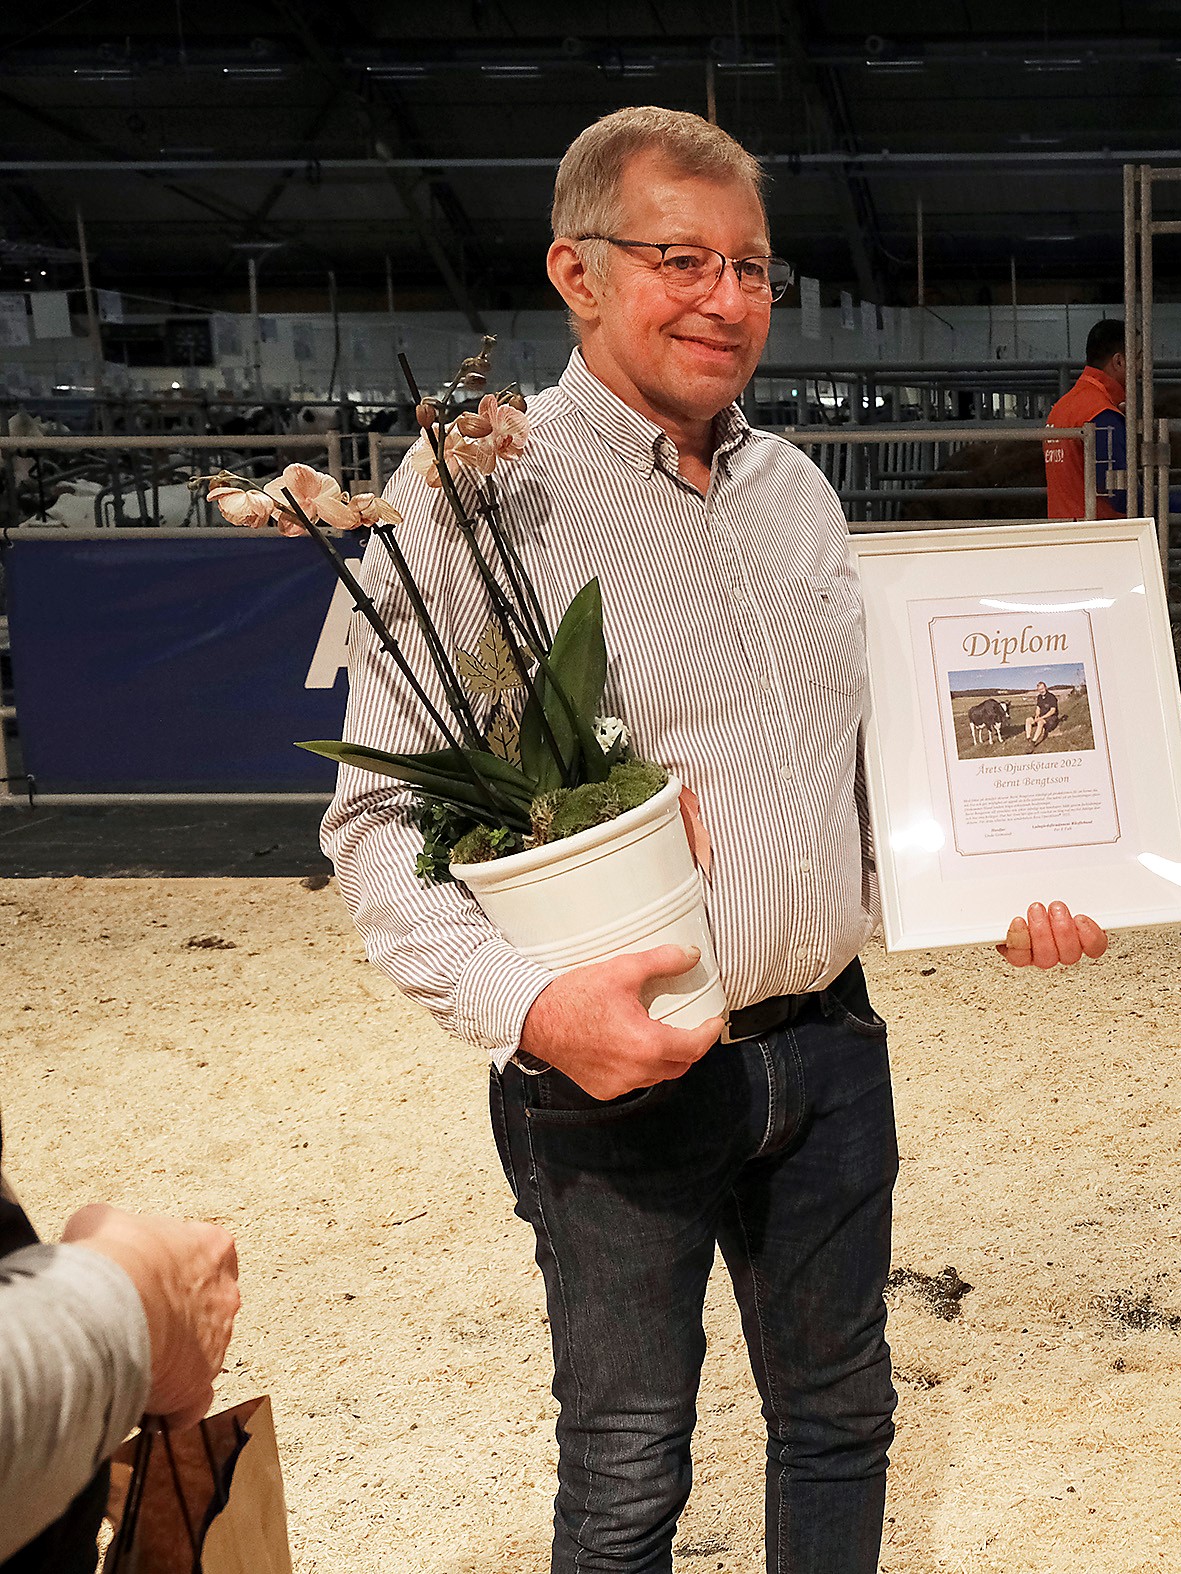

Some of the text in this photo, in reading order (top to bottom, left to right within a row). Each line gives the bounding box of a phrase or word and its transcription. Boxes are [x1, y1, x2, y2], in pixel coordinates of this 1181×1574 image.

[962, 625, 1069, 664] Diplom
[976, 757, 1083, 776] Årets Djurskötare 2022
[993, 775, 1070, 789] Bernt Bengtsson
